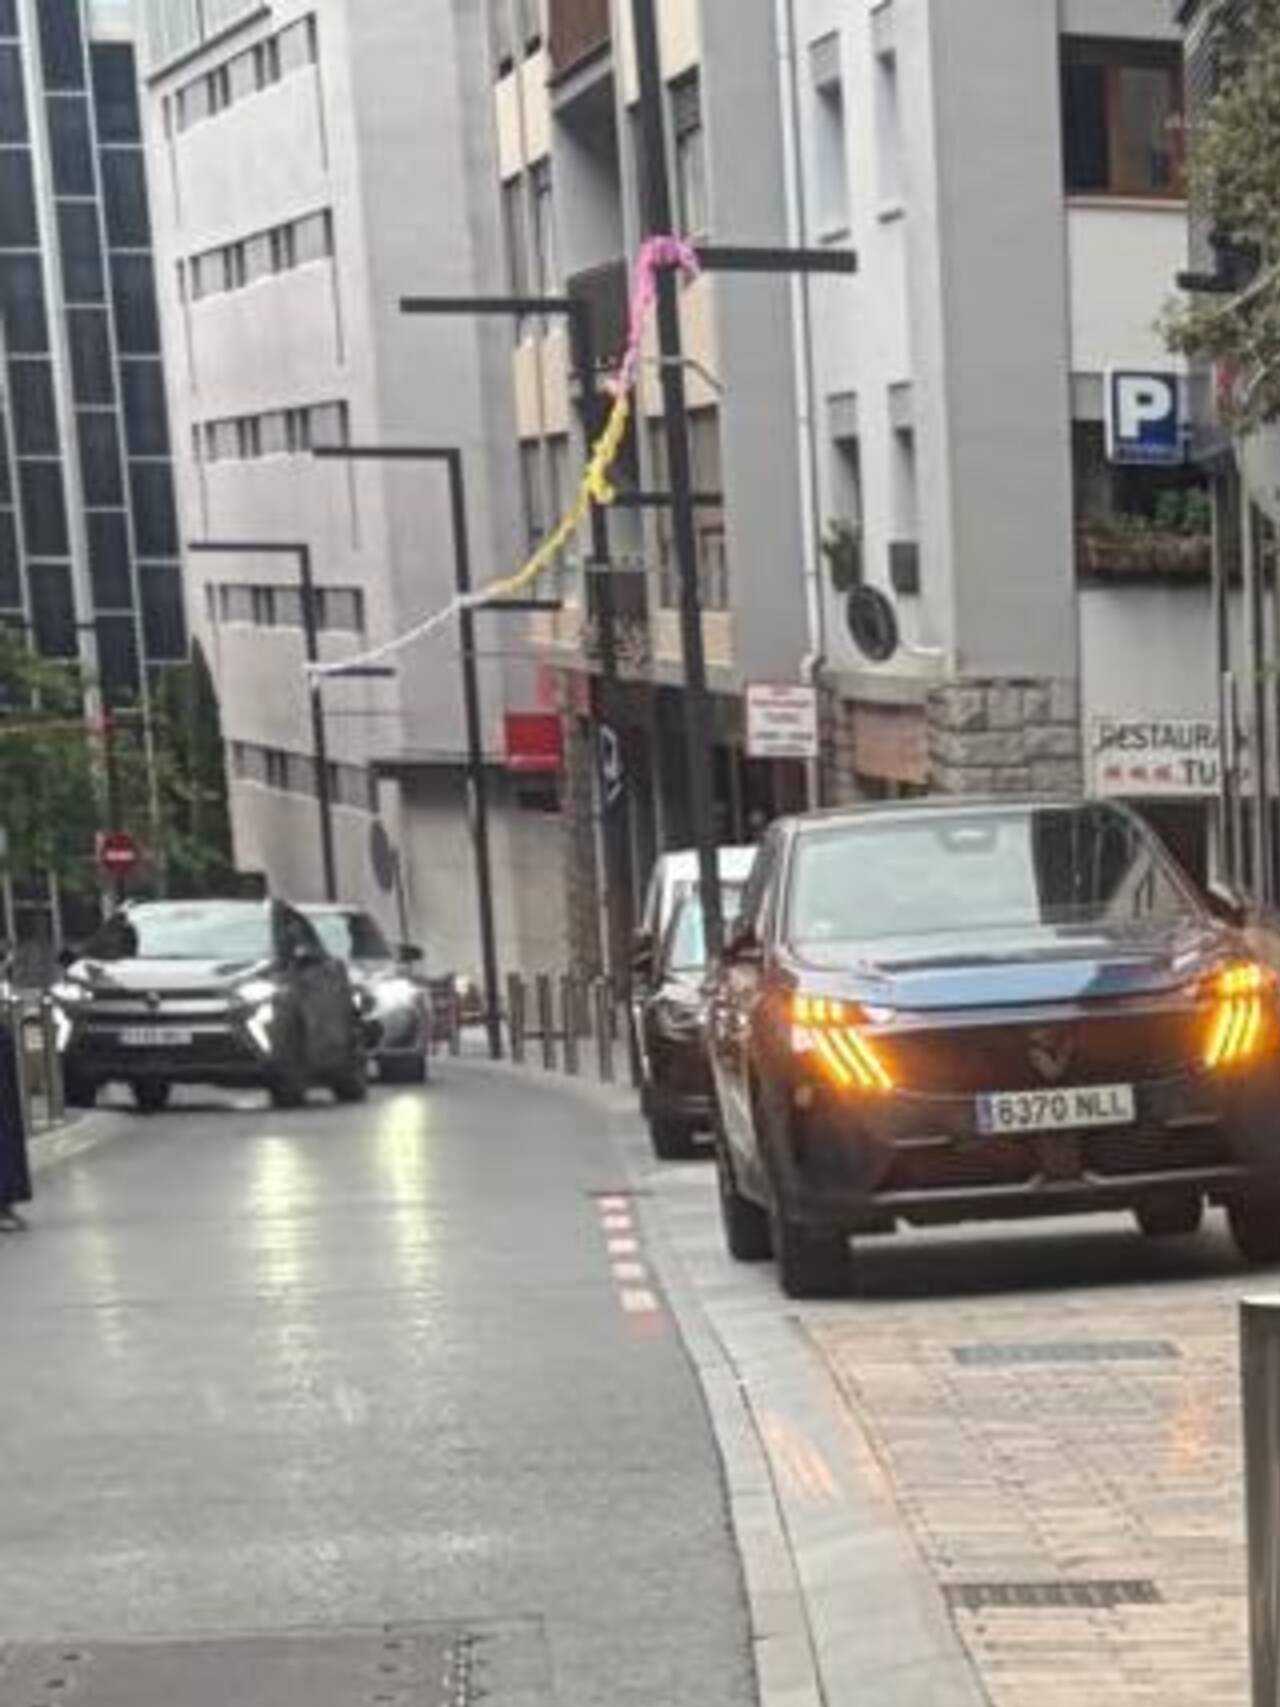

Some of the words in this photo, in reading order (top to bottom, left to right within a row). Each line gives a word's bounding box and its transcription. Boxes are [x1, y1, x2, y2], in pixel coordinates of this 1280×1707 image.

[1118, 375, 1172, 438] P
[998, 1094, 1069, 1126] 6370
[1075, 1090, 1129, 1119] NLL
